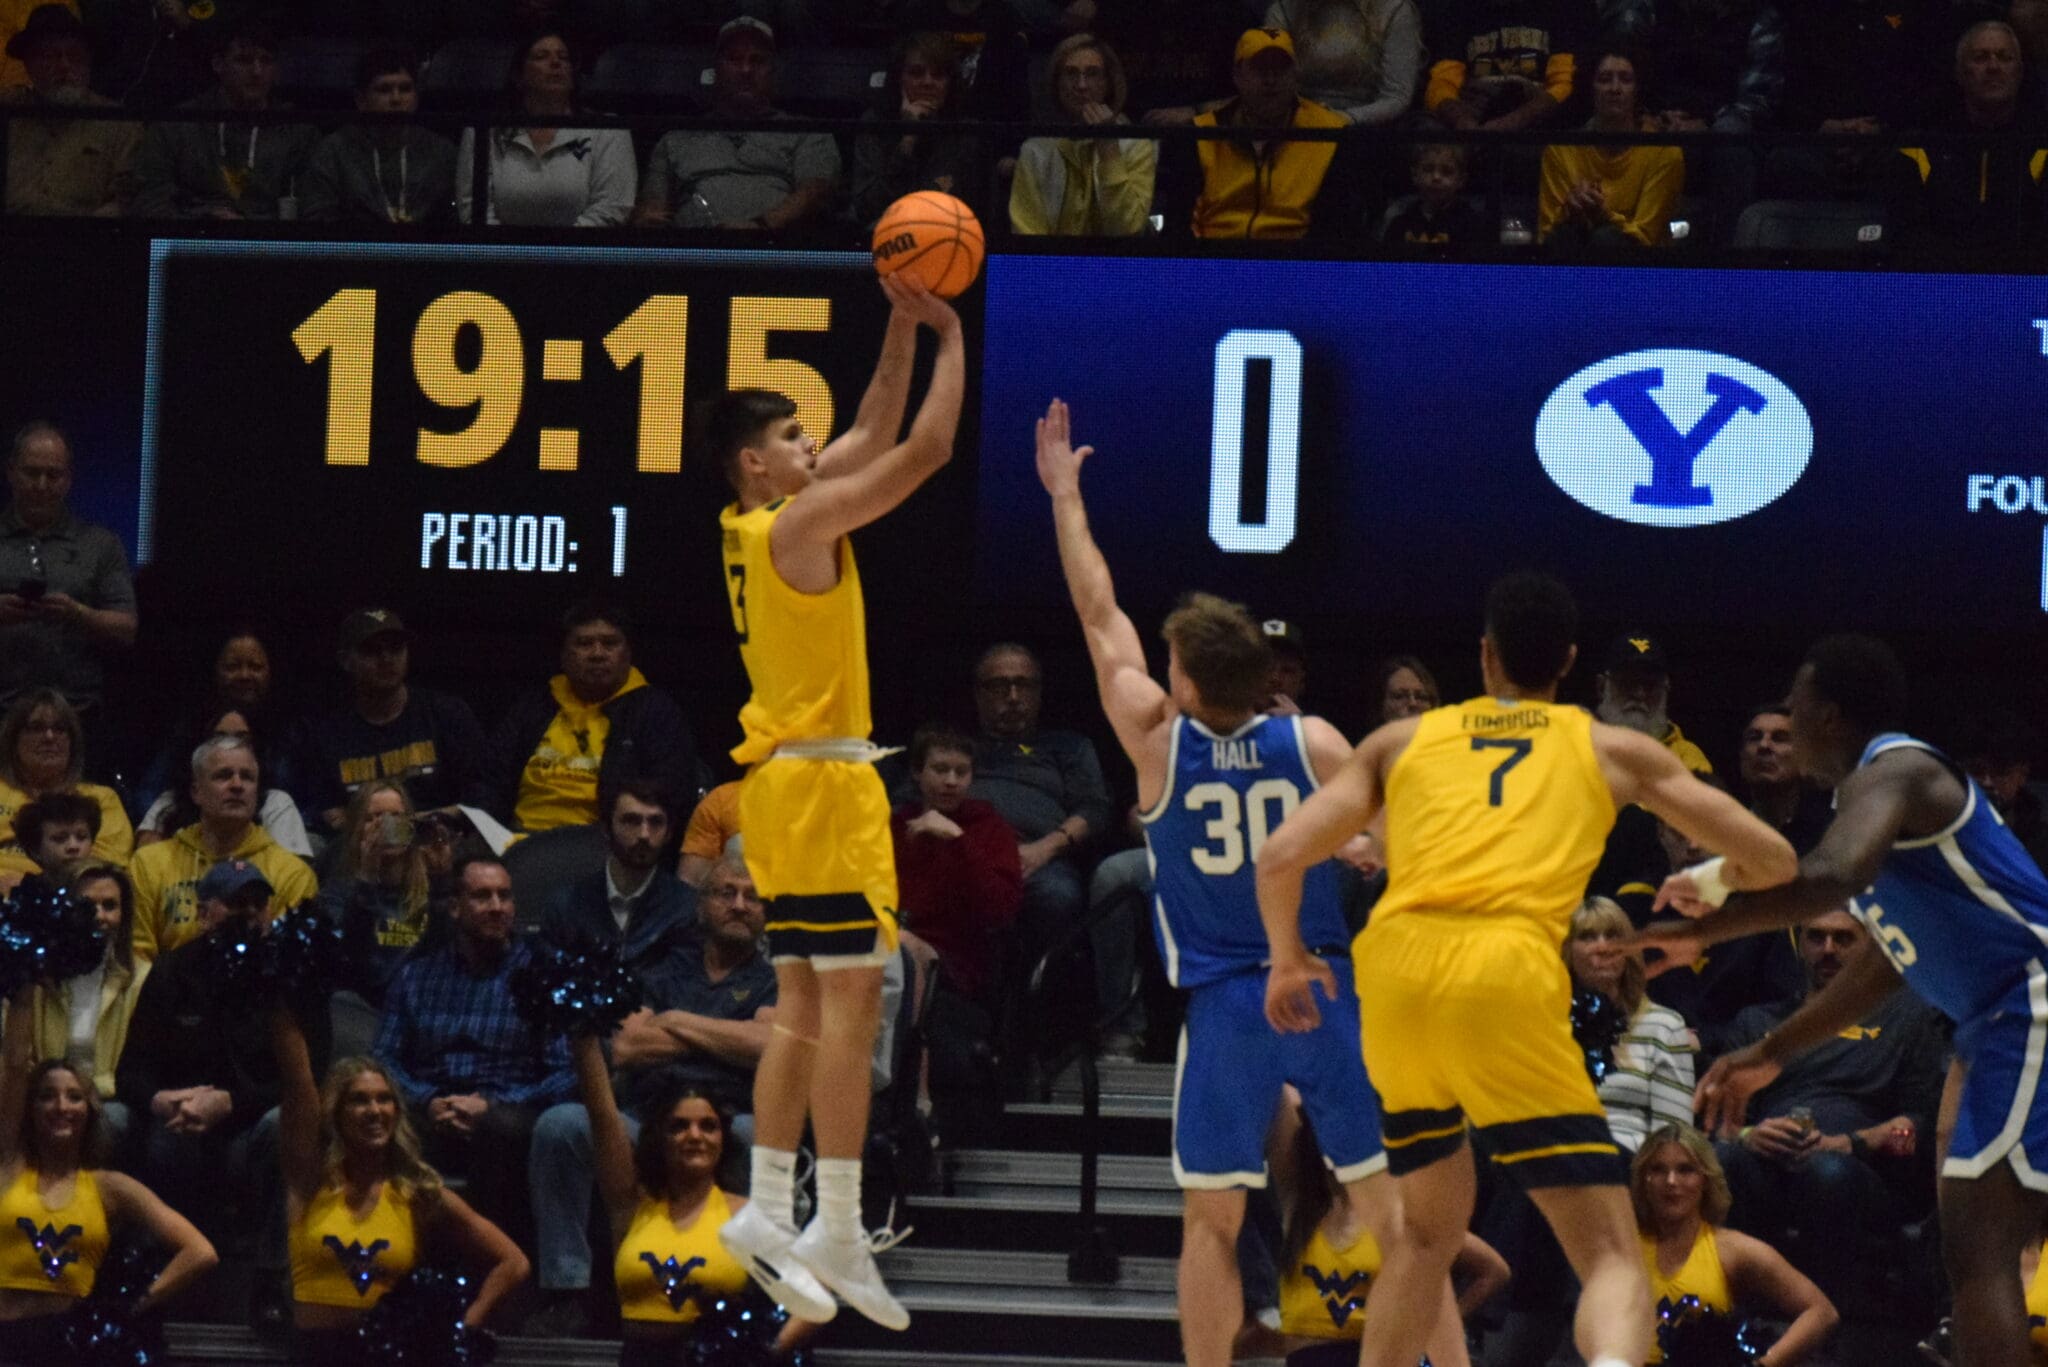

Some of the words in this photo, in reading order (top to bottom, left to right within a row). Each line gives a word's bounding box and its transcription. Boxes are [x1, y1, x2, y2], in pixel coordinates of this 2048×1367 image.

[291, 288, 836, 473] 19:15
[1208, 329, 1304, 553] 0
[1583, 367, 1768, 507] Y
[420, 511, 580, 573] PERIOD:
[610, 505, 629, 578] 1
[1211, 739, 1264, 771] HALL
[1471, 737, 1533, 807] 7
[1184, 777, 1301, 876] 30
